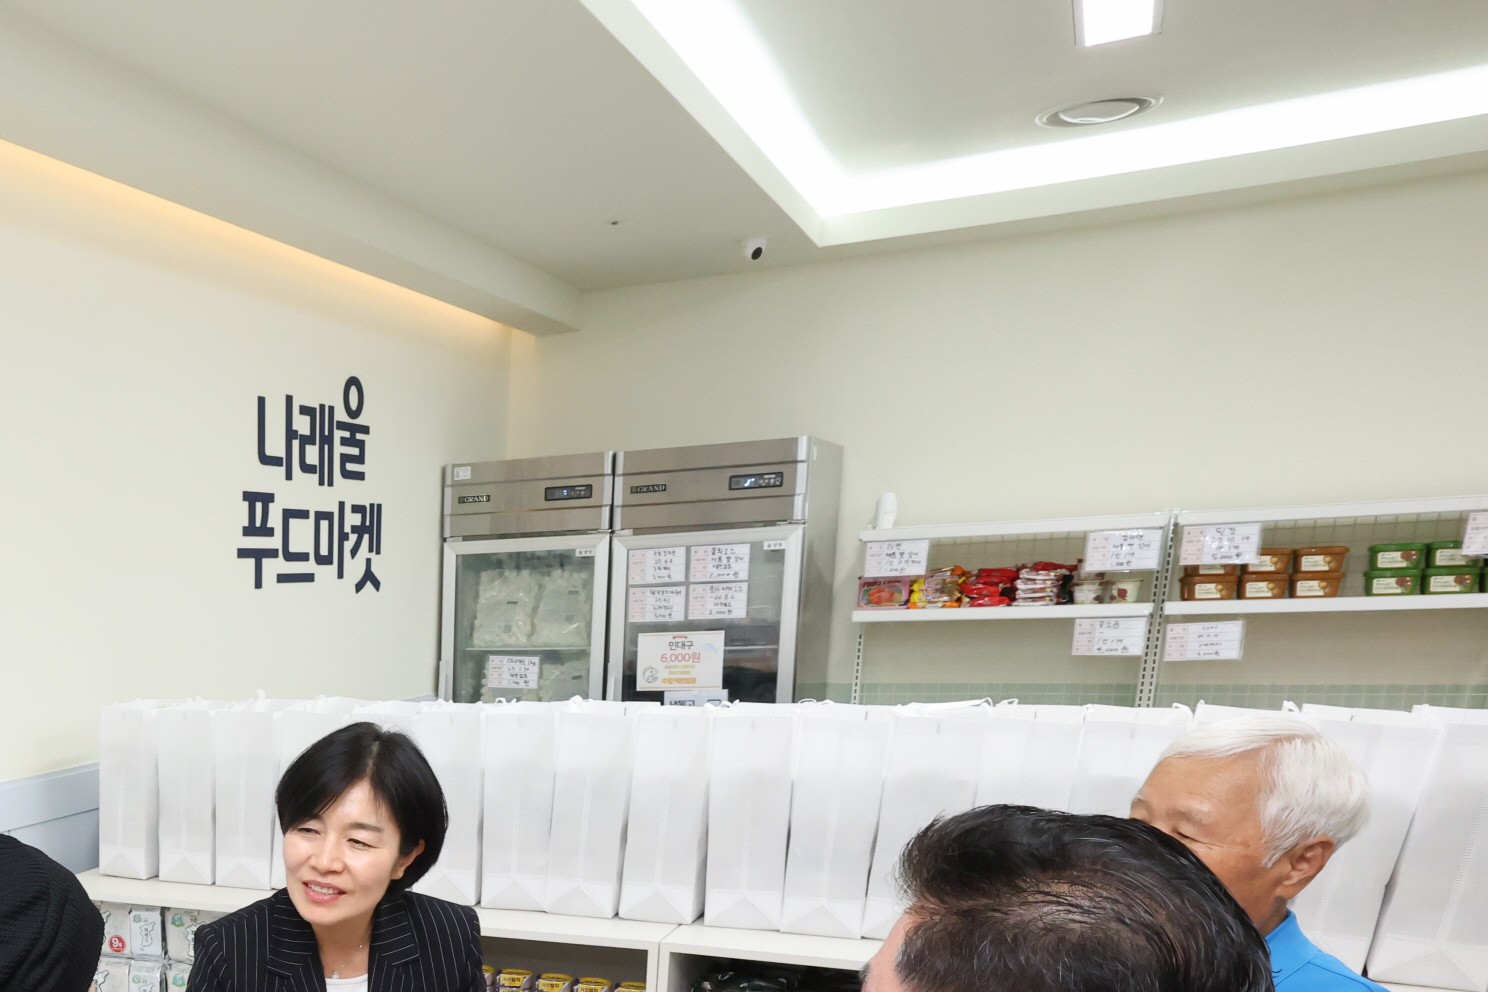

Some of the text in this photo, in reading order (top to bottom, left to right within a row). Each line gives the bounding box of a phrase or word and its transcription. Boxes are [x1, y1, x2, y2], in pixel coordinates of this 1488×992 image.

[257, 375, 370, 487] 나래울
[637, 484, 666, 493] GRAND
[237, 490, 382, 595] 푸드마켓
[660, 652, 701, 664] 6,000원
